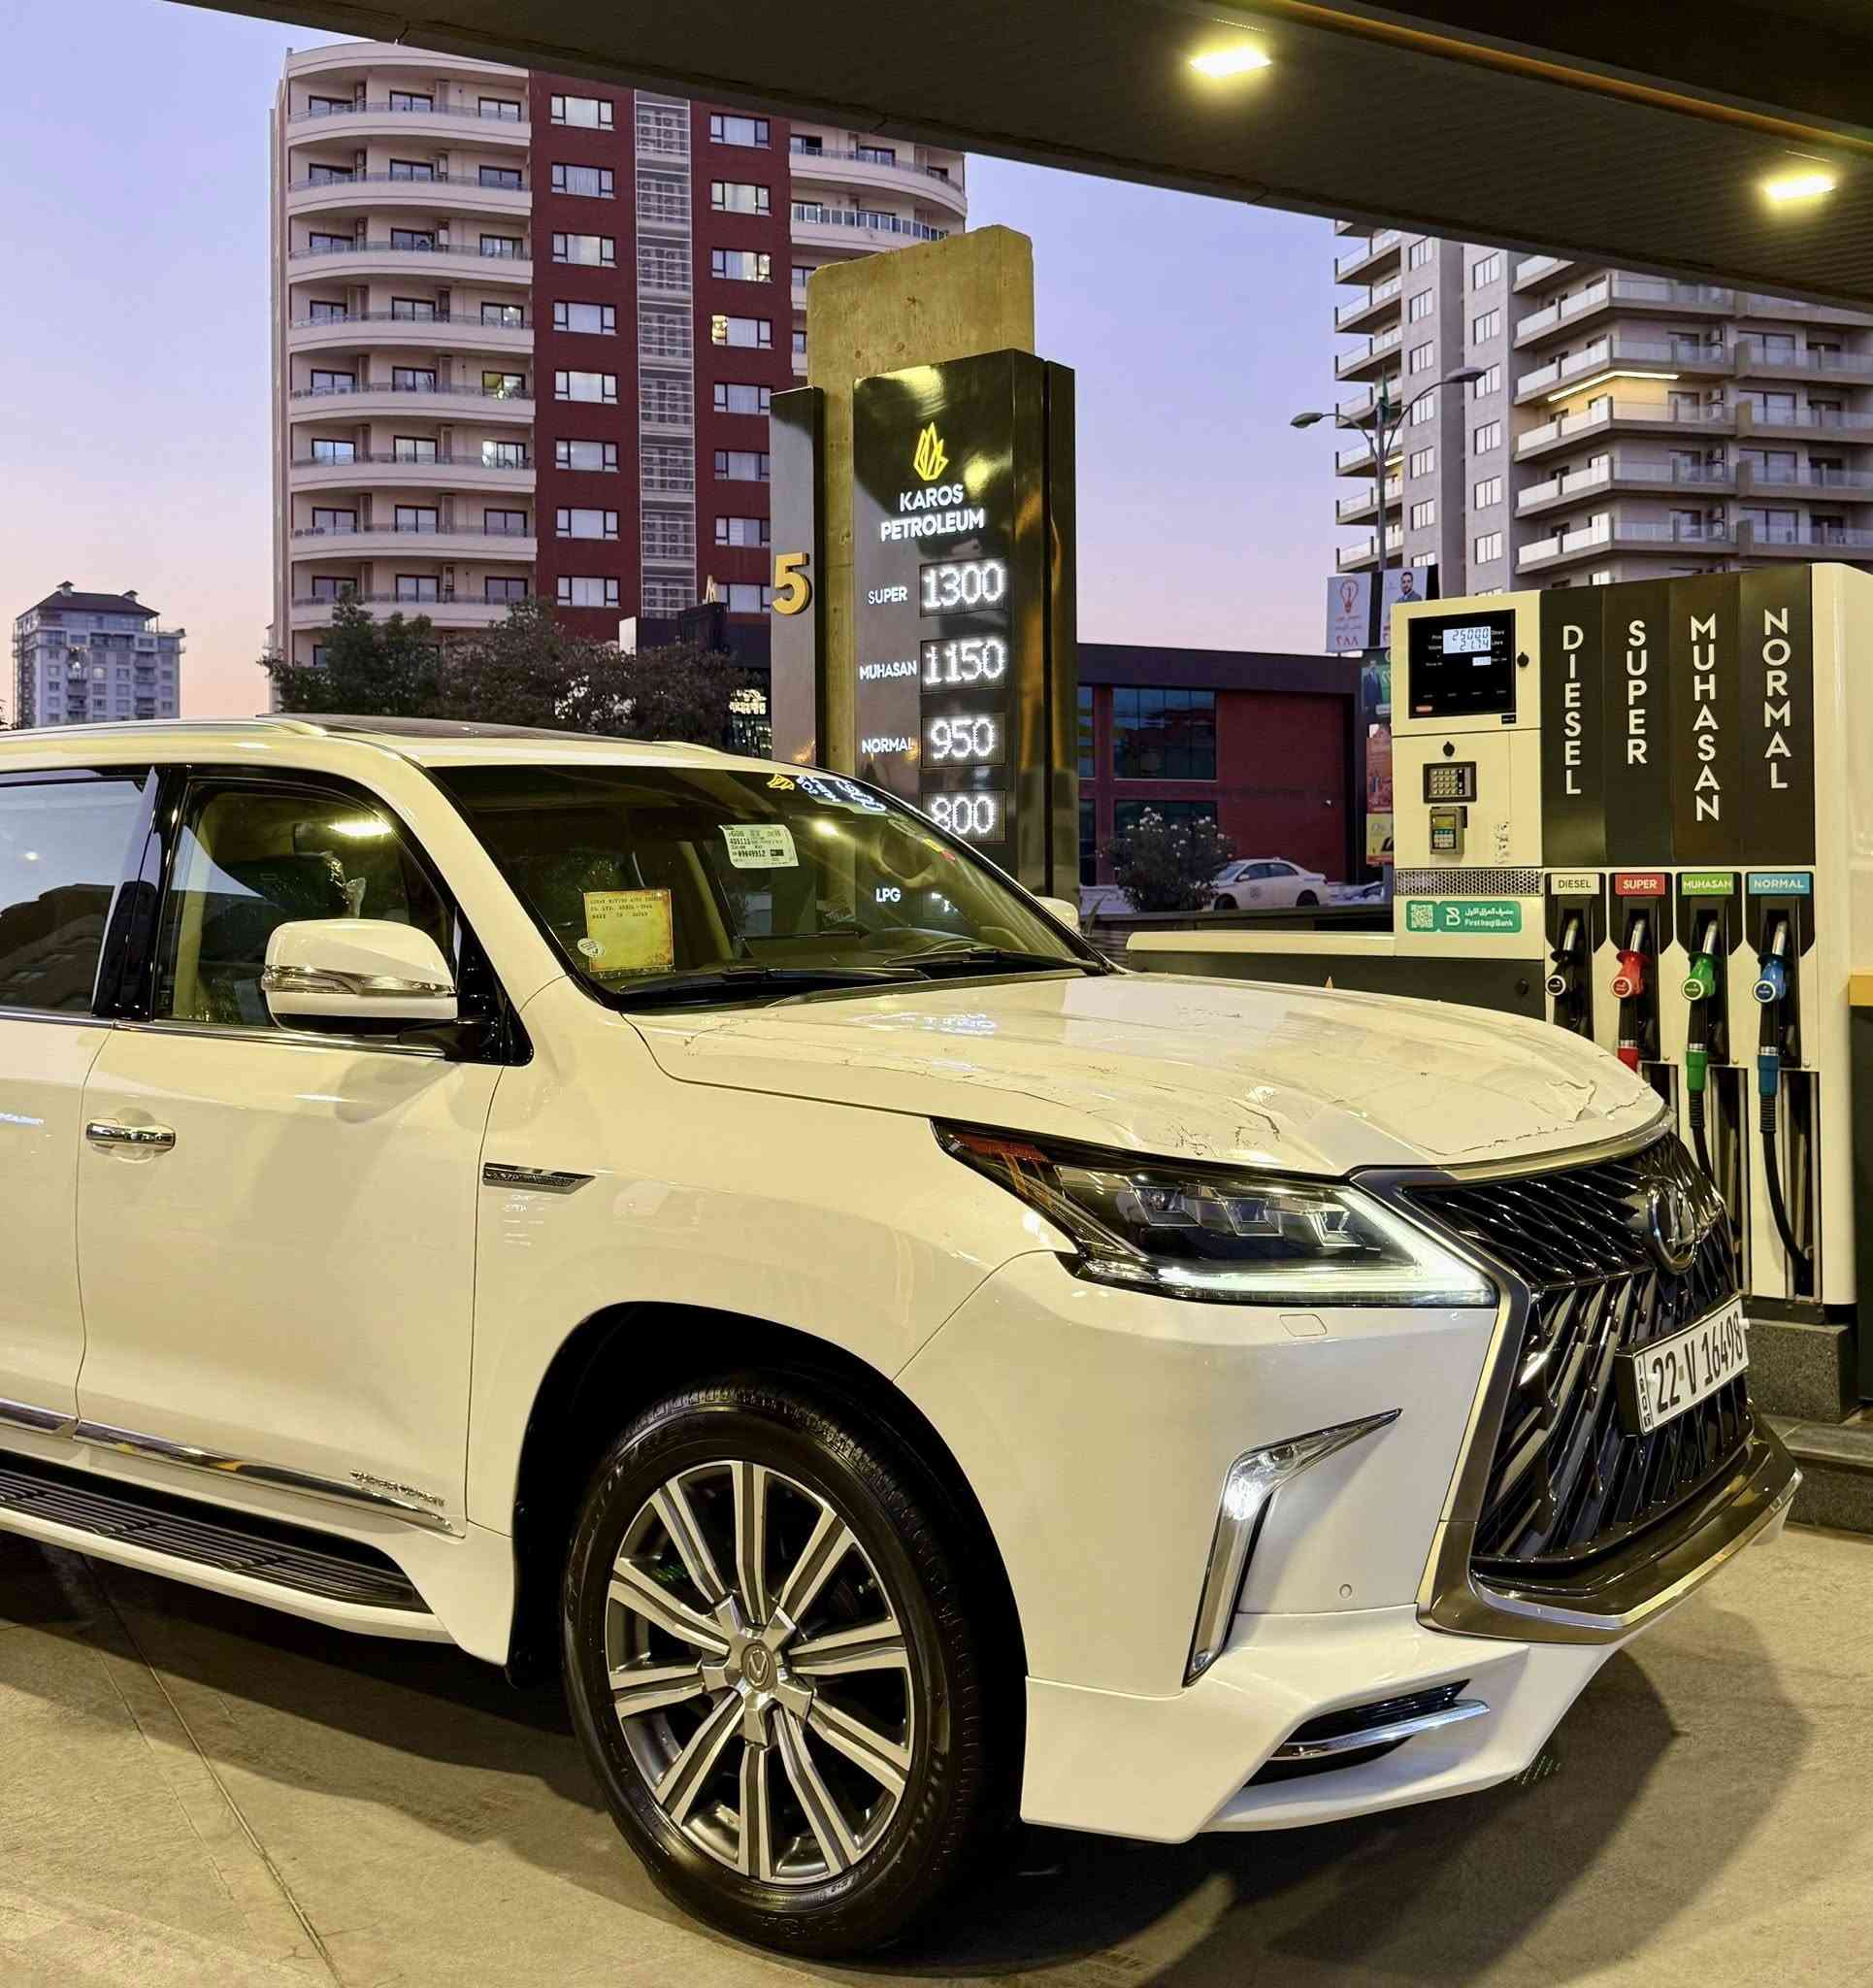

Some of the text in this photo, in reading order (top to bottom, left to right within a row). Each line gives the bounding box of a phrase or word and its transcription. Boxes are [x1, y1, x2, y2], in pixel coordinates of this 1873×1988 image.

[900, 484, 964, 513] KAROS
[881, 508, 985, 542] PETROLEUM
[772, 551, 812, 615] 5
[868, 561, 1006, 610] SUPER 1300
[1452, 627, 1490, 642] 25000
[859, 639, 1005, 684] MUHASAN 1150
[1562, 624, 1585, 795] DIESEL
[1626, 619, 1649, 765] SUPER
[1761, 607, 1792, 789] NORMAL
[862, 714, 996, 760] NORMAL 950
[1690, 613, 1721, 822] MUHASAN
[931, 795, 995, 836] 800
[875, 887, 902, 903] LPG
[1558, 878, 1593, 890] DIESEL
[1622, 878, 1659, 890] SUPER
[1682, 878, 1733, 890] MUHASAN
[1753, 878, 1805, 890] NORMAL
[1653, 1310, 1744, 1414] 22 V 16498
